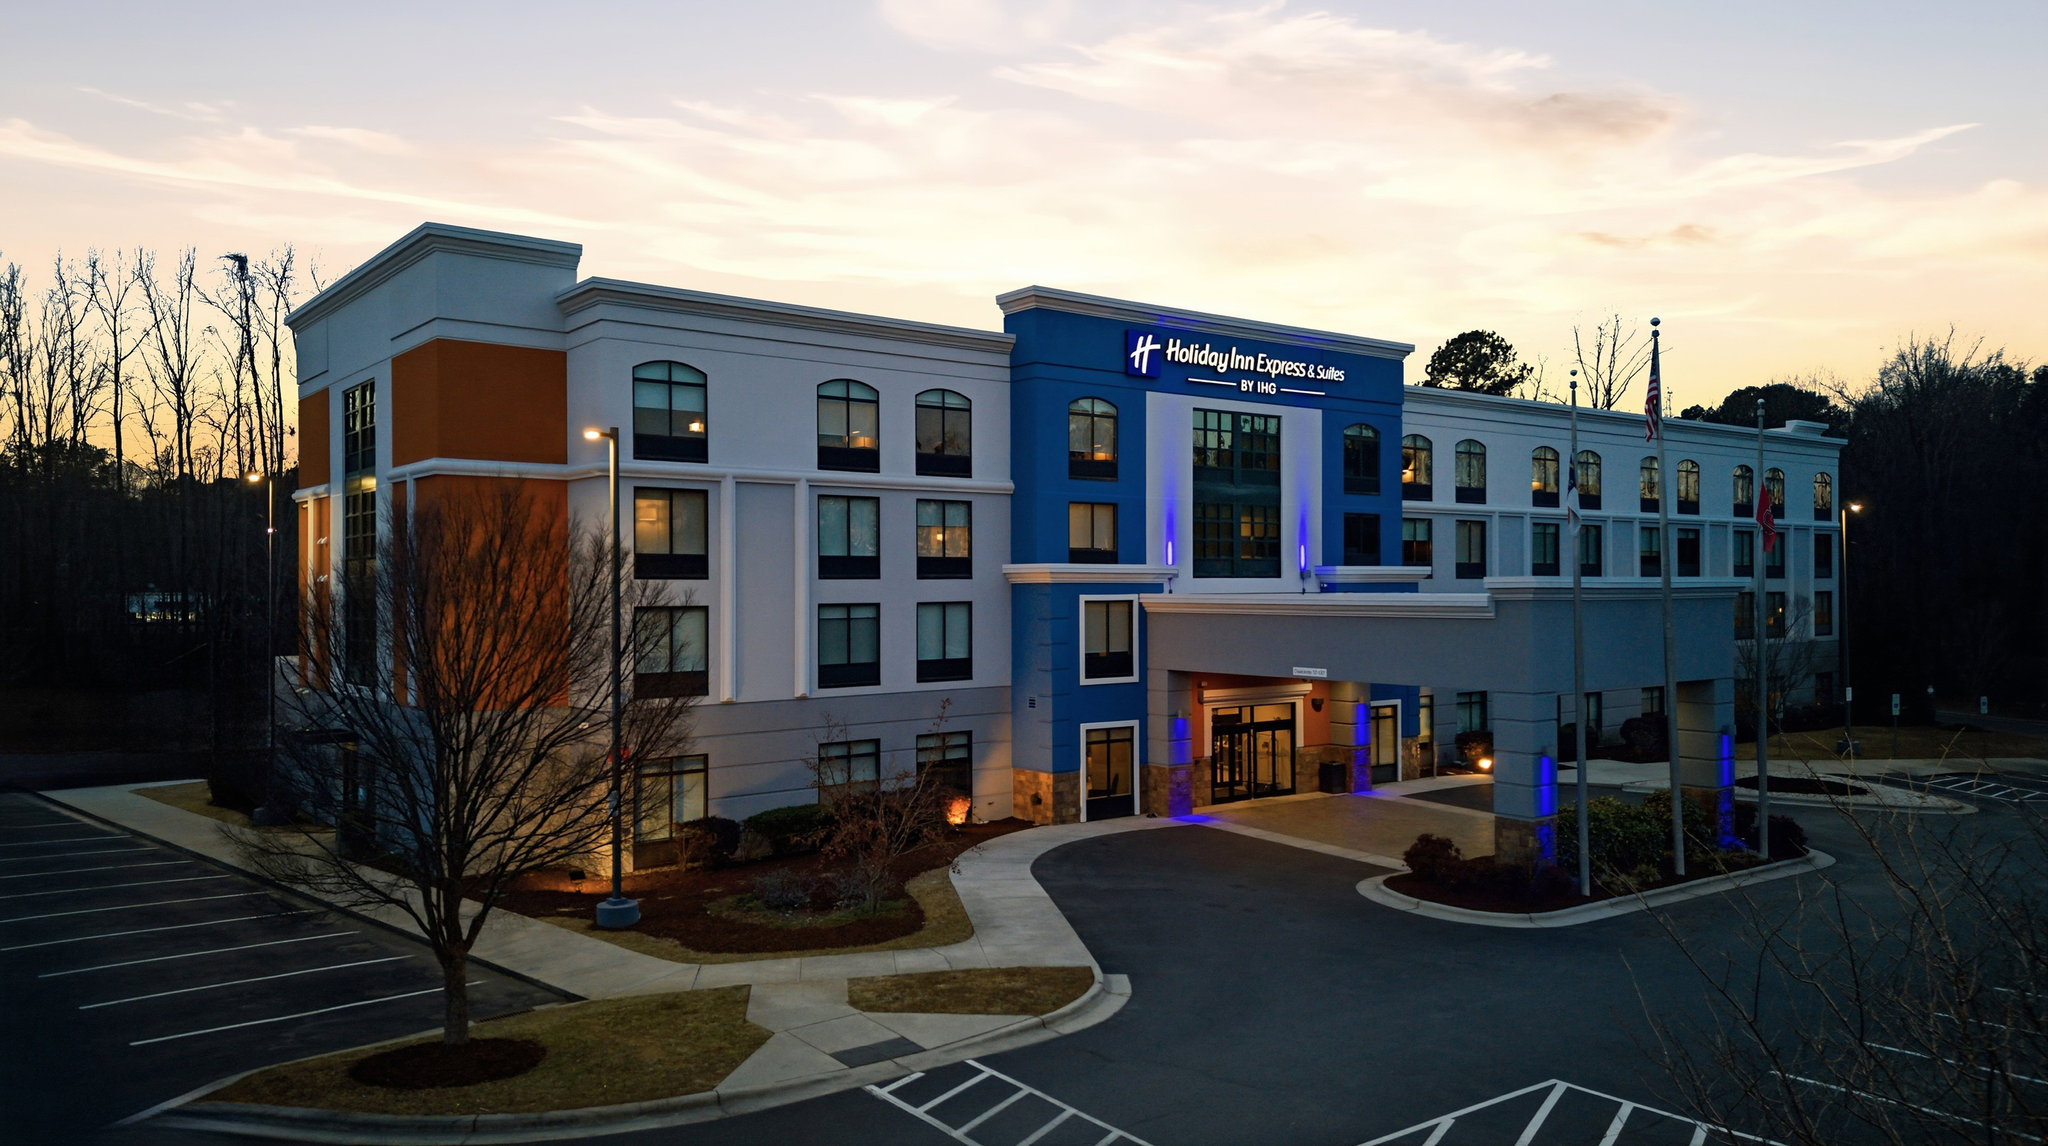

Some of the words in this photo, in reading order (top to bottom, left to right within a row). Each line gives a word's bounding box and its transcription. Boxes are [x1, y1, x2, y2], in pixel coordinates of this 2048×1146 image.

[1166, 338, 1229, 373] Holiday
[1230, 346, 1255, 371] Inn
[1256, 353, 1306, 378] Express
[1307, 364, 1315, 379] &
[1316, 364, 1345, 381] Suites
[1240, 379, 1254, 392] BY
[1257, 381, 1277, 394] IHG
